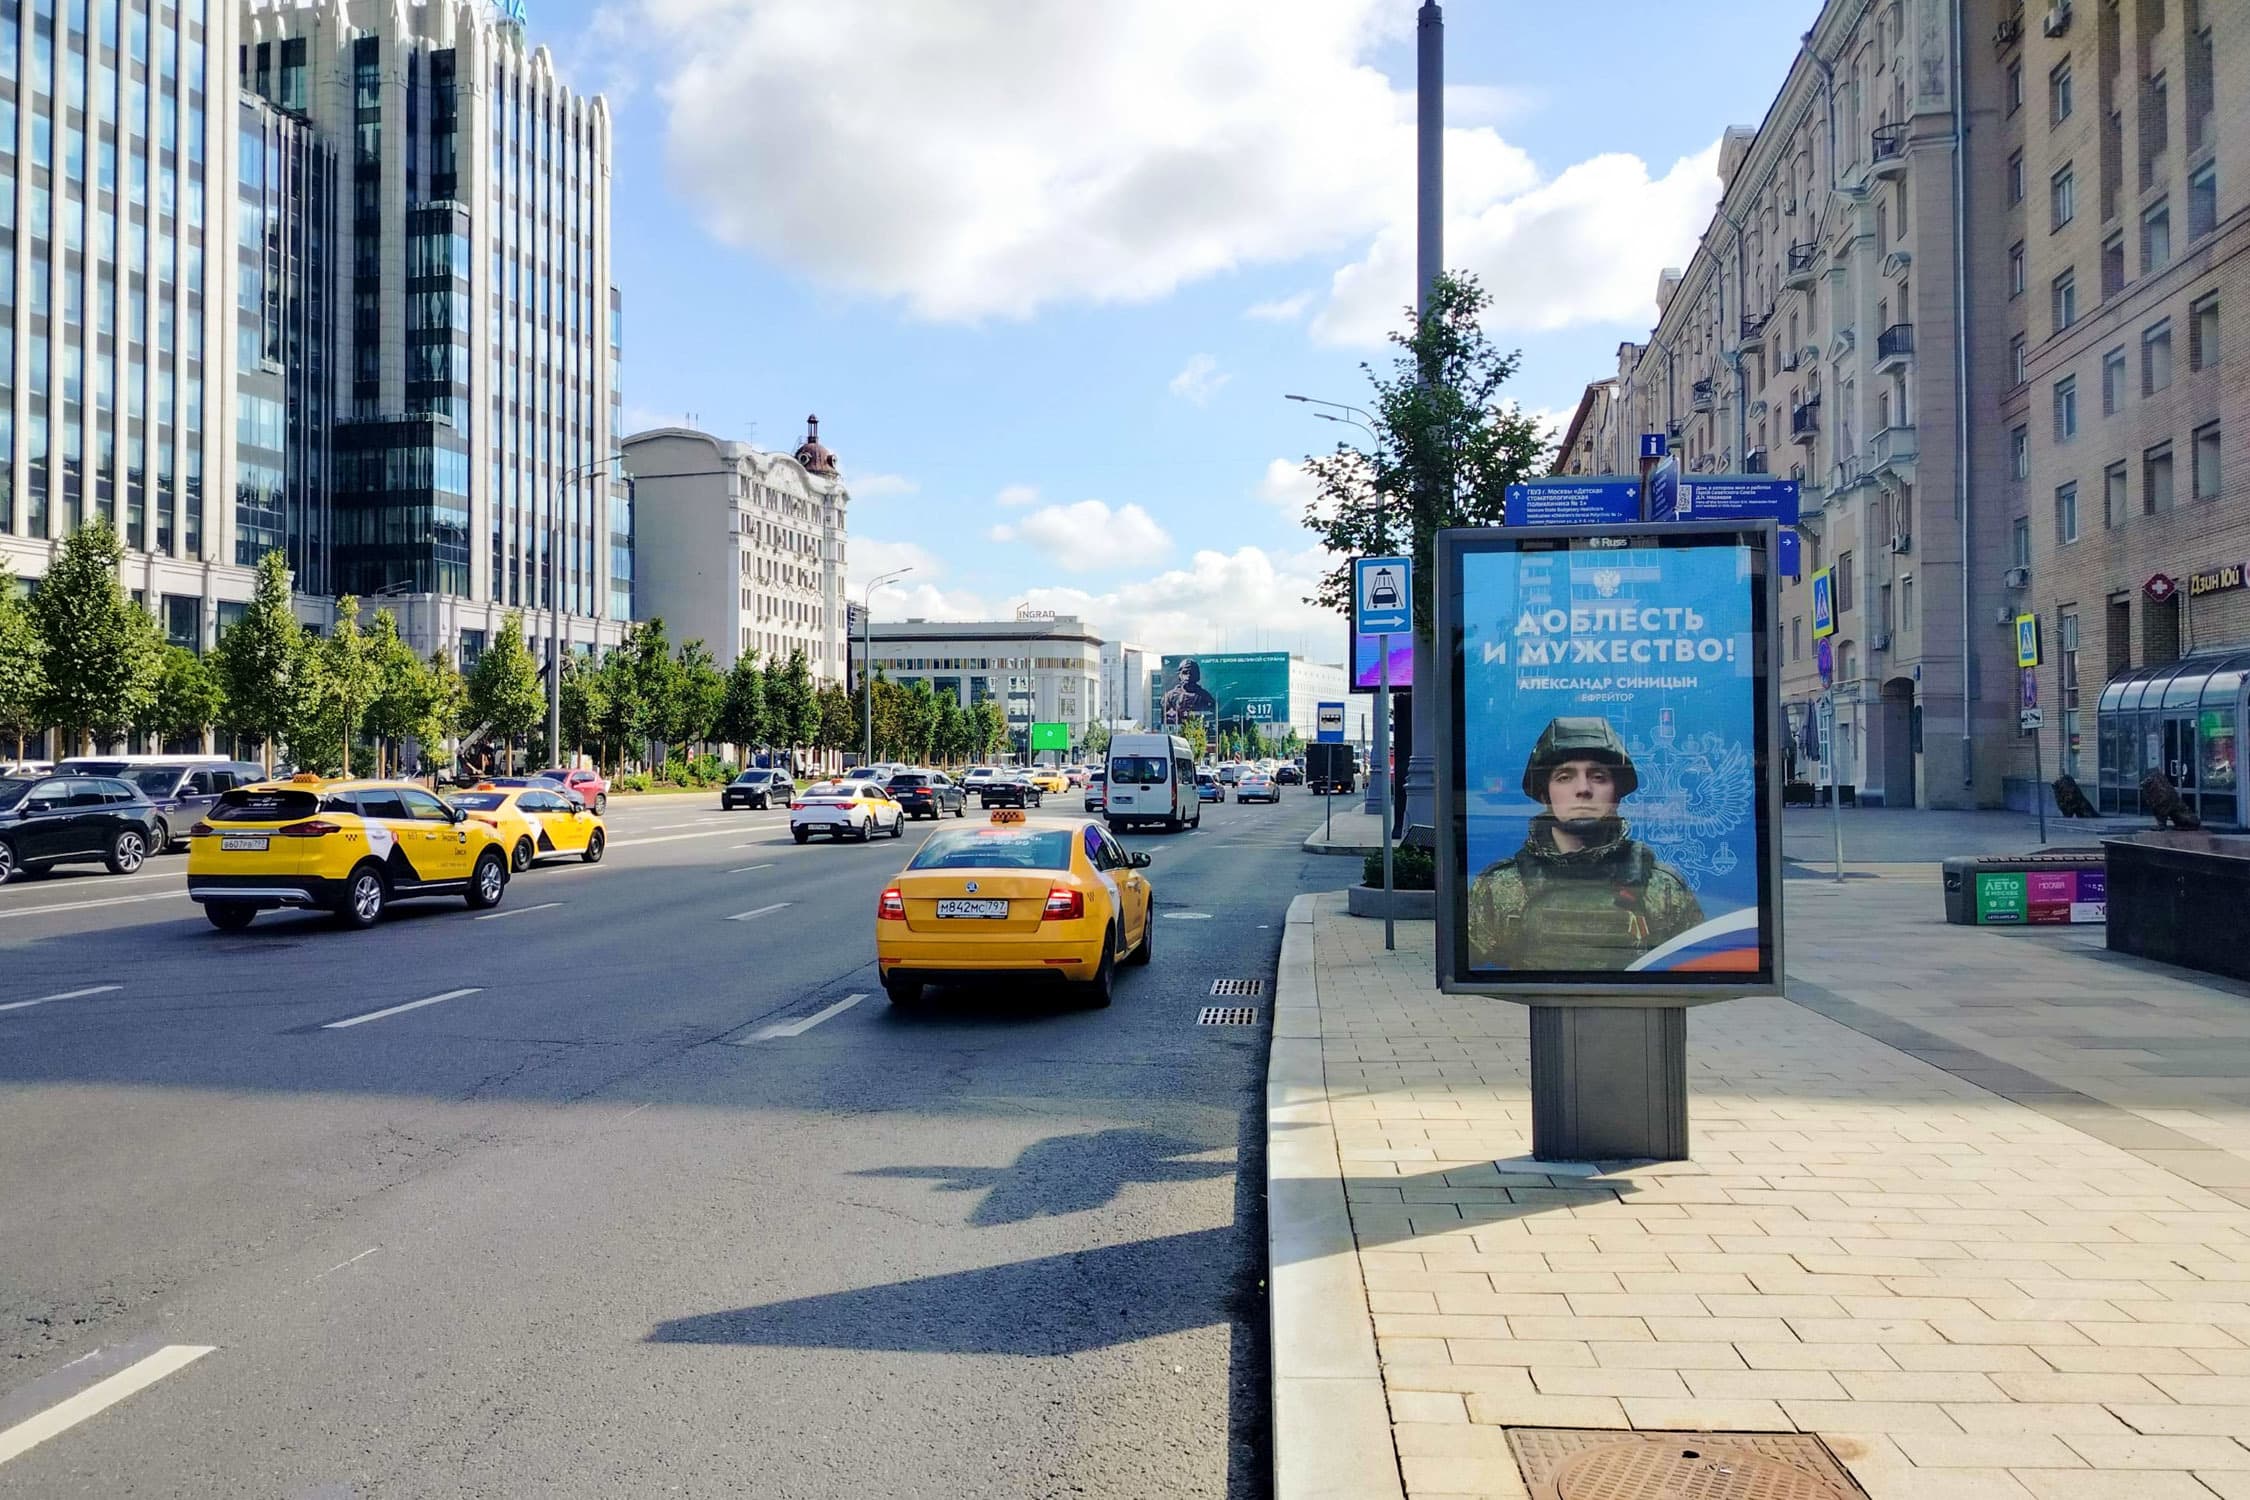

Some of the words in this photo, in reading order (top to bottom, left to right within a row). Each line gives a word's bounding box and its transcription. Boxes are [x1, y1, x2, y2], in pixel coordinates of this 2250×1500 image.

[1527, 494, 1588, 502] стоматологическая
[1602, 538, 1628, 547] Russ
[1018, 610, 1056, 619] INGRAD
[1514, 607, 1704, 636] ДОБЛЕСТЬ
[1484, 641, 1506, 664] И
[1520, 638, 1735, 664] МУЖЕСТВО!
[1519, 677, 1611, 690] АЛЕКСАНДР
[1616, 676, 1698, 689] СИНИЦЫН
[1581, 692, 1634, 702] ЕФРЕЙТОР
[1257, 703, 1272, 715] 117
[1985, 881, 2019, 890] ЛЕТО
